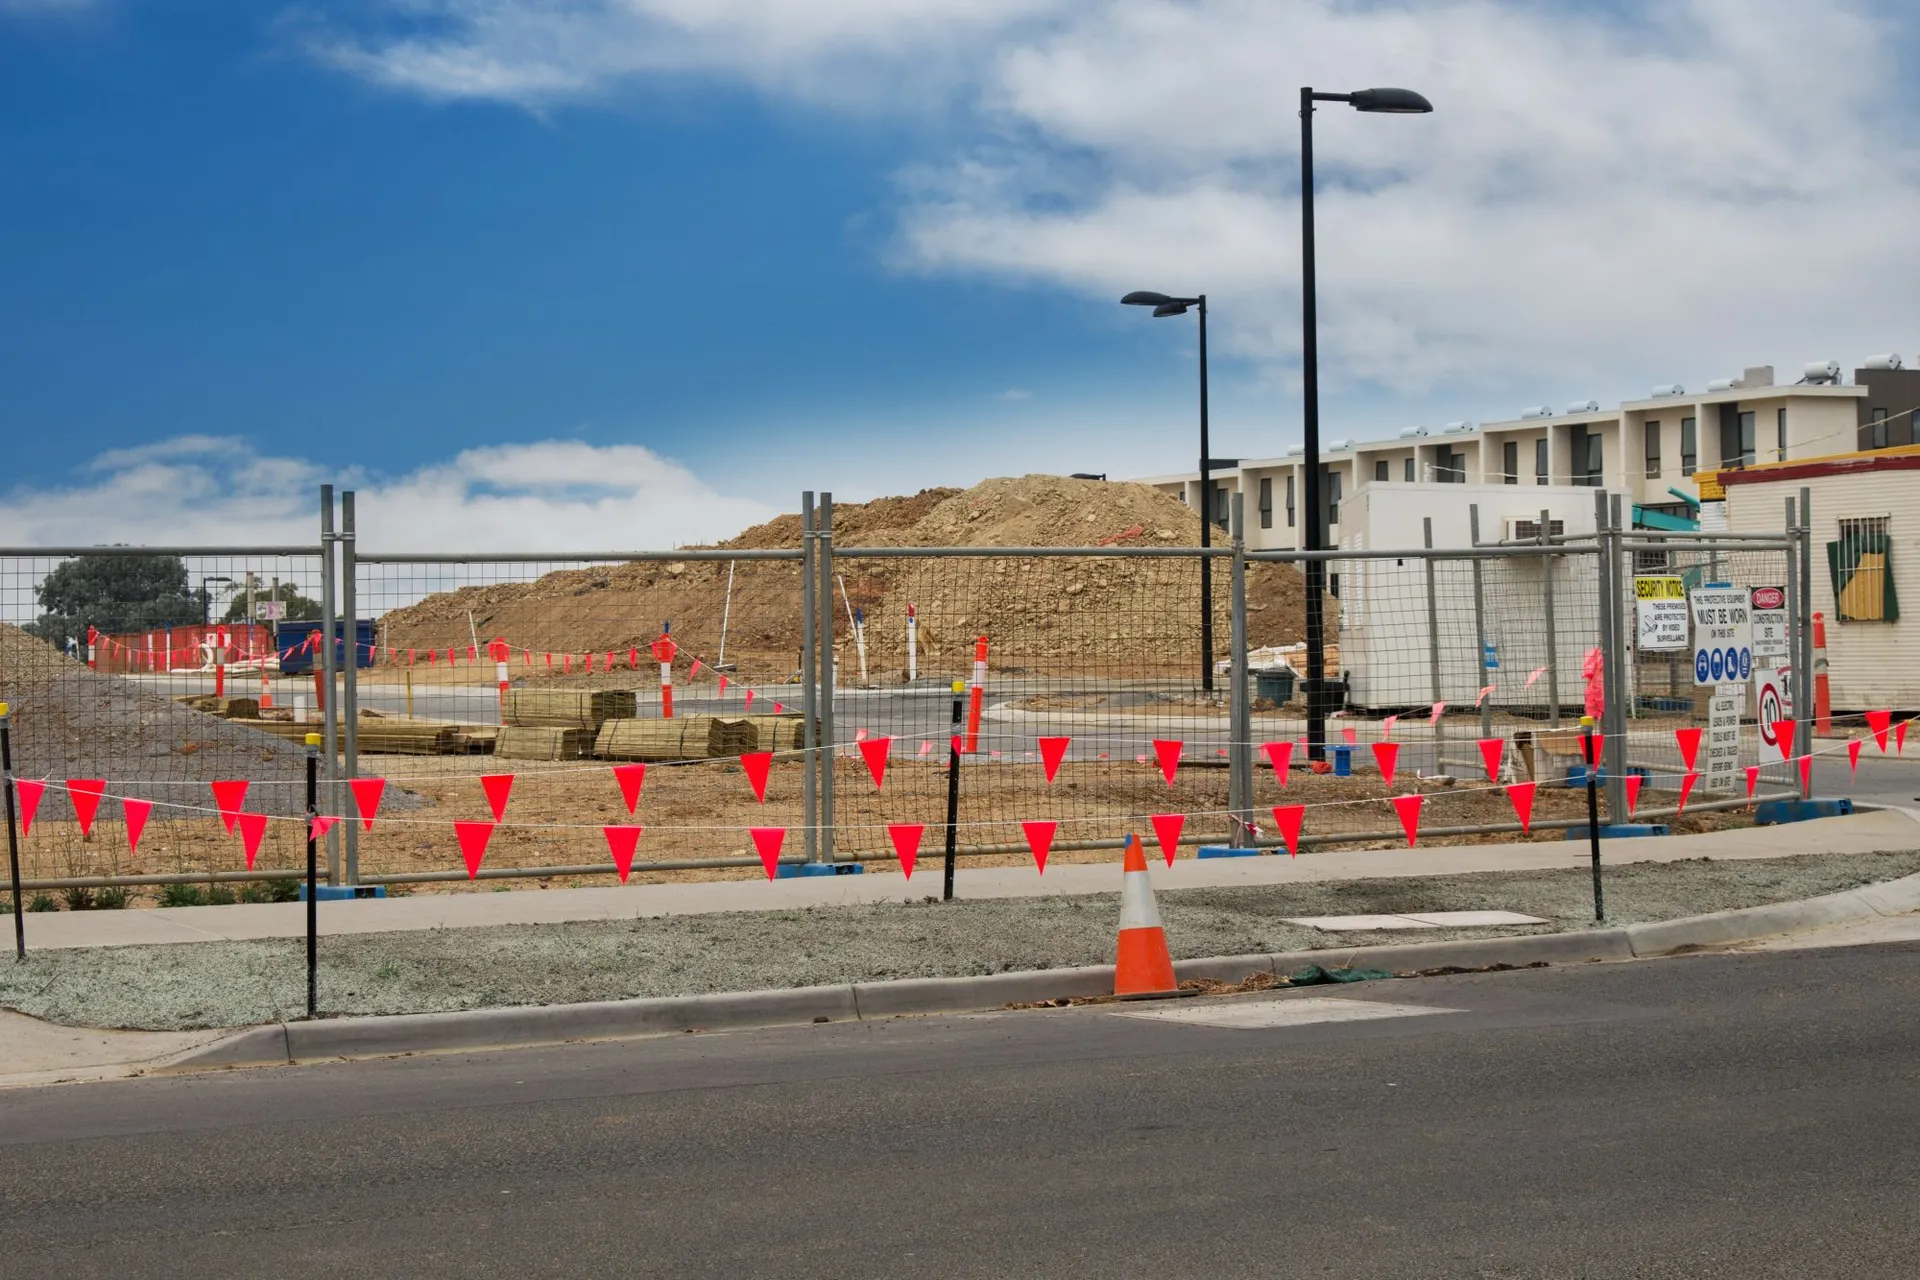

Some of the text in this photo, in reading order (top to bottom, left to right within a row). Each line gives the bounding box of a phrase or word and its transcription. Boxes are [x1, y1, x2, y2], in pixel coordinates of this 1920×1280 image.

[1637, 580, 1664, 597] SECURITY
[1756, 592, 1779, 604] DANGER
[1697, 608, 1748, 624] MUST BE WORN
[1754, 613, 1784, 624] CONSTRUCTION
[1764, 627, 1774, 638] SITE
[1764, 697, 1777, 731] 10
